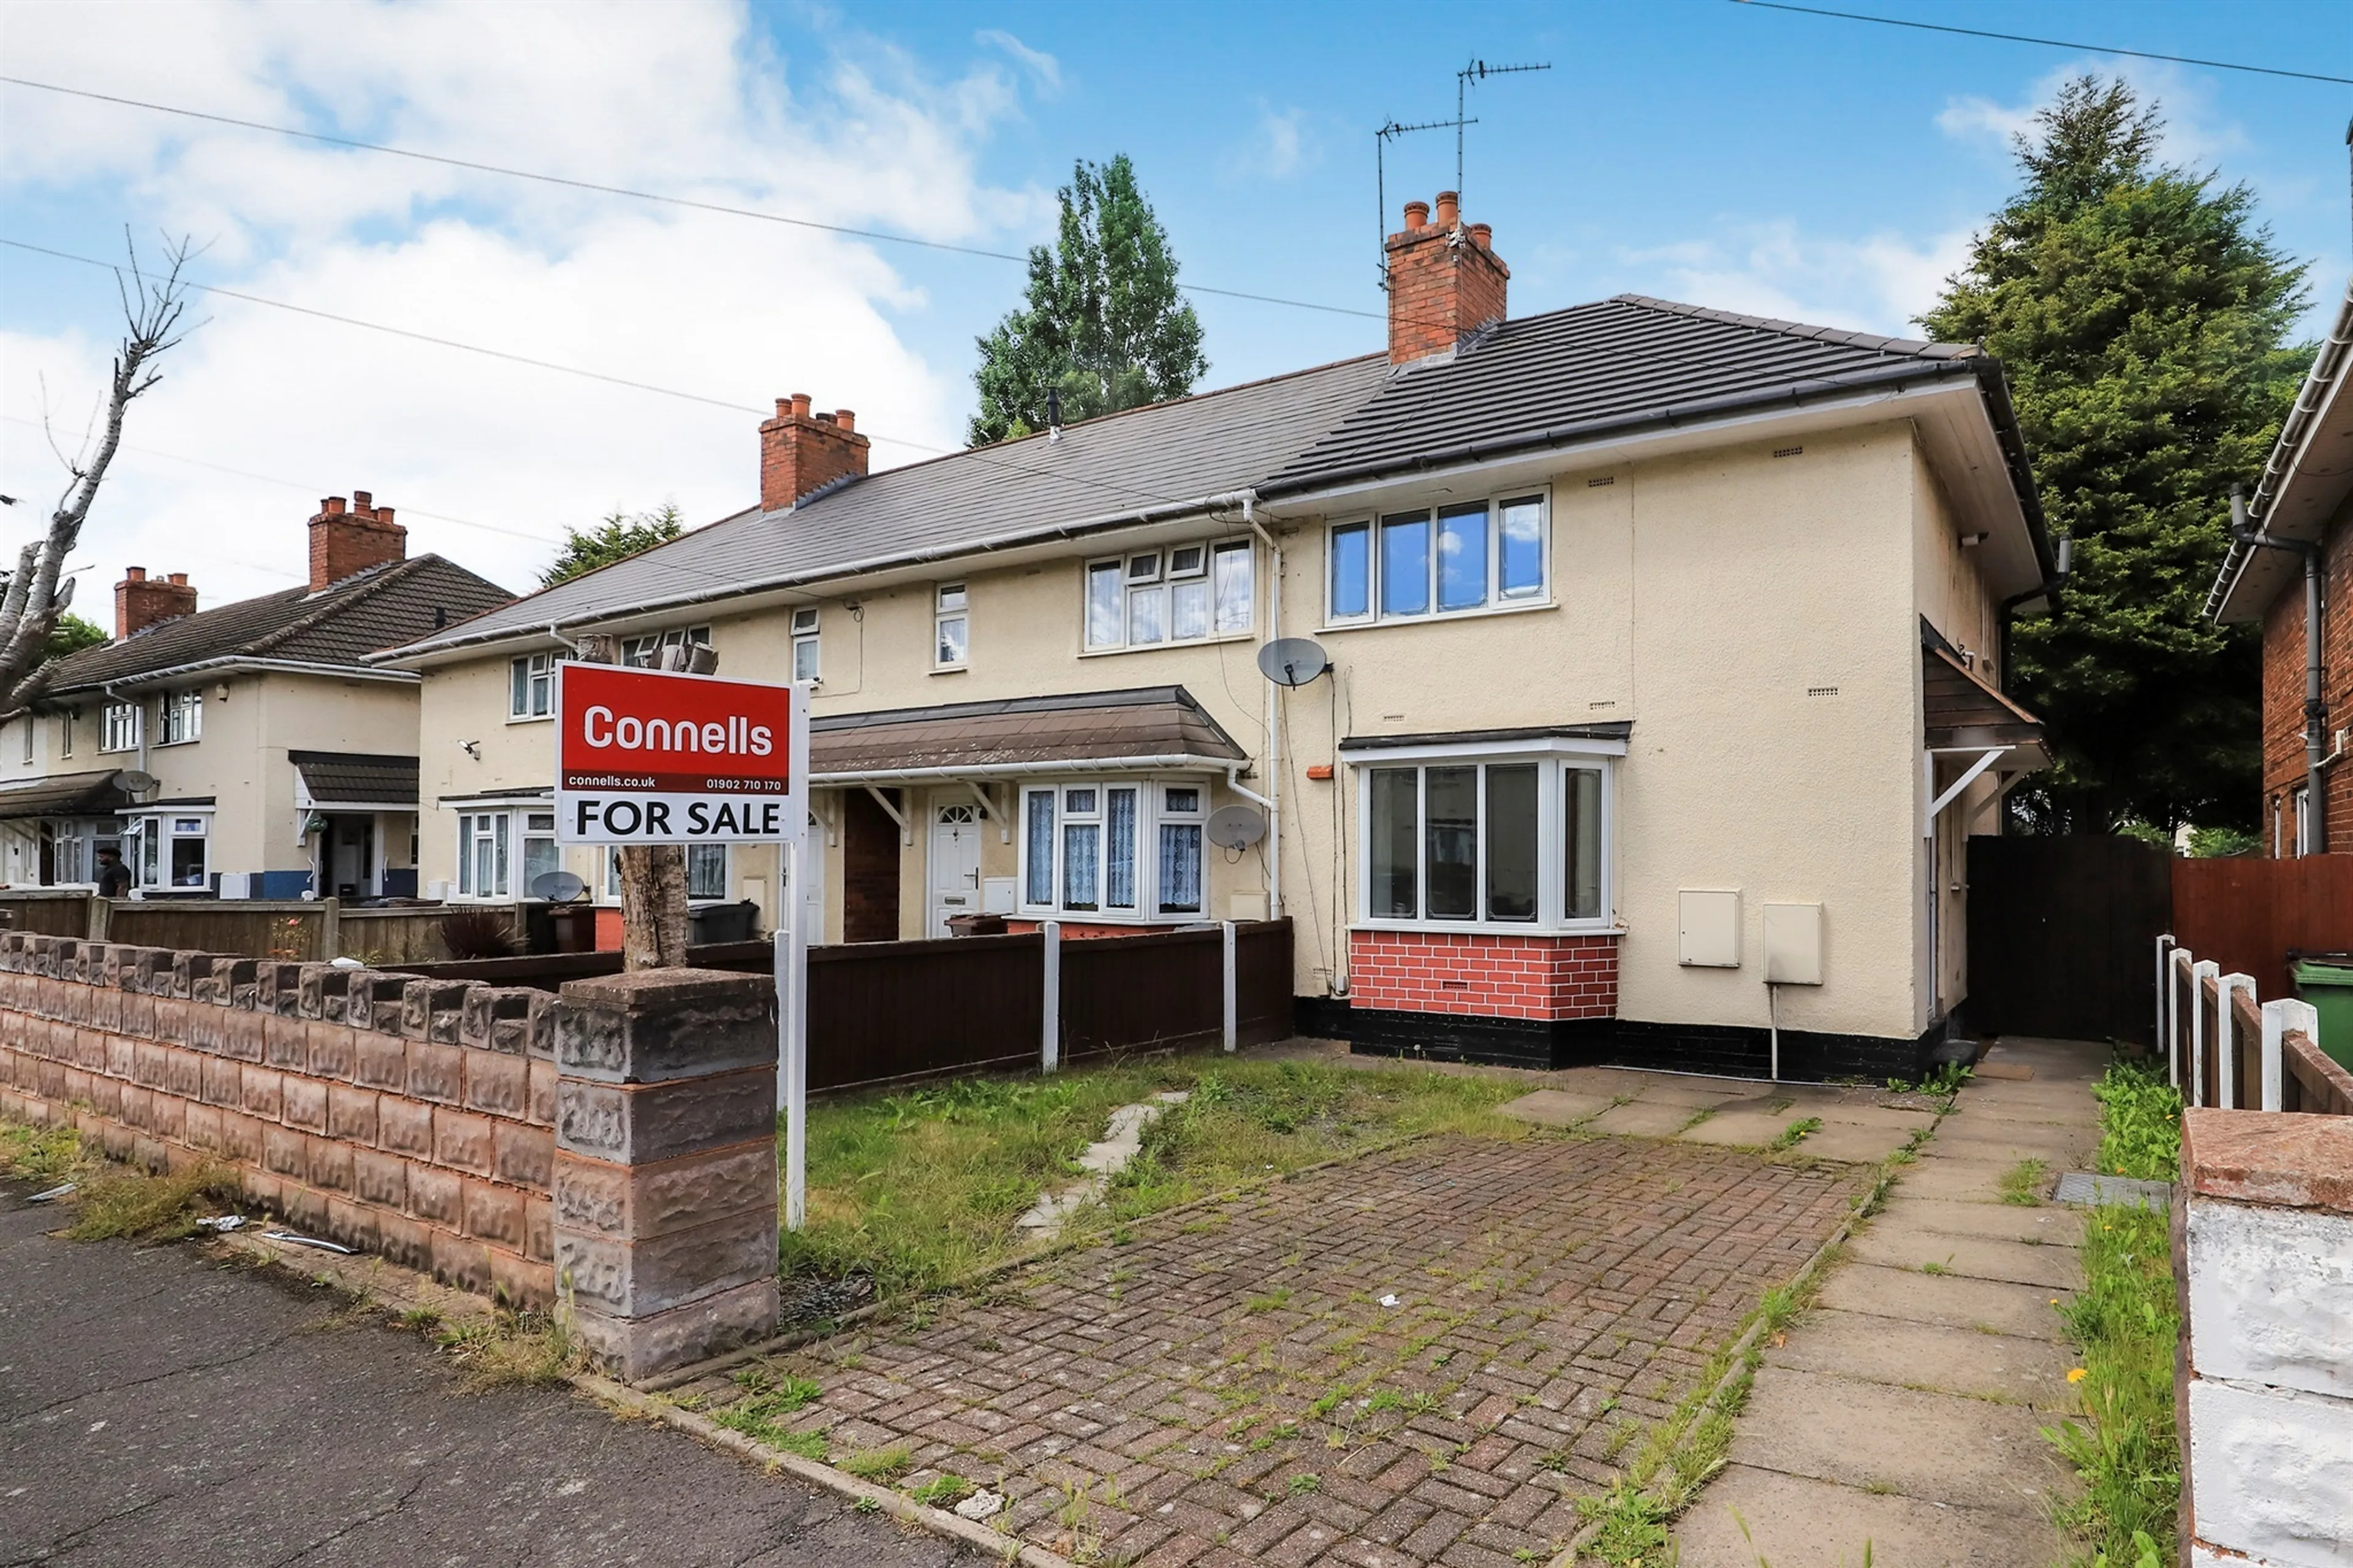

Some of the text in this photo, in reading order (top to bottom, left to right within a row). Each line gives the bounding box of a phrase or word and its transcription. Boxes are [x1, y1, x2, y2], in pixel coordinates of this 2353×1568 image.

[584, 705, 772, 756] Connells
[569, 775, 656, 788] connells.co.uk
[707, 779, 781, 791] 01902 710 170
[577, 800, 780, 835] FOR SALE
